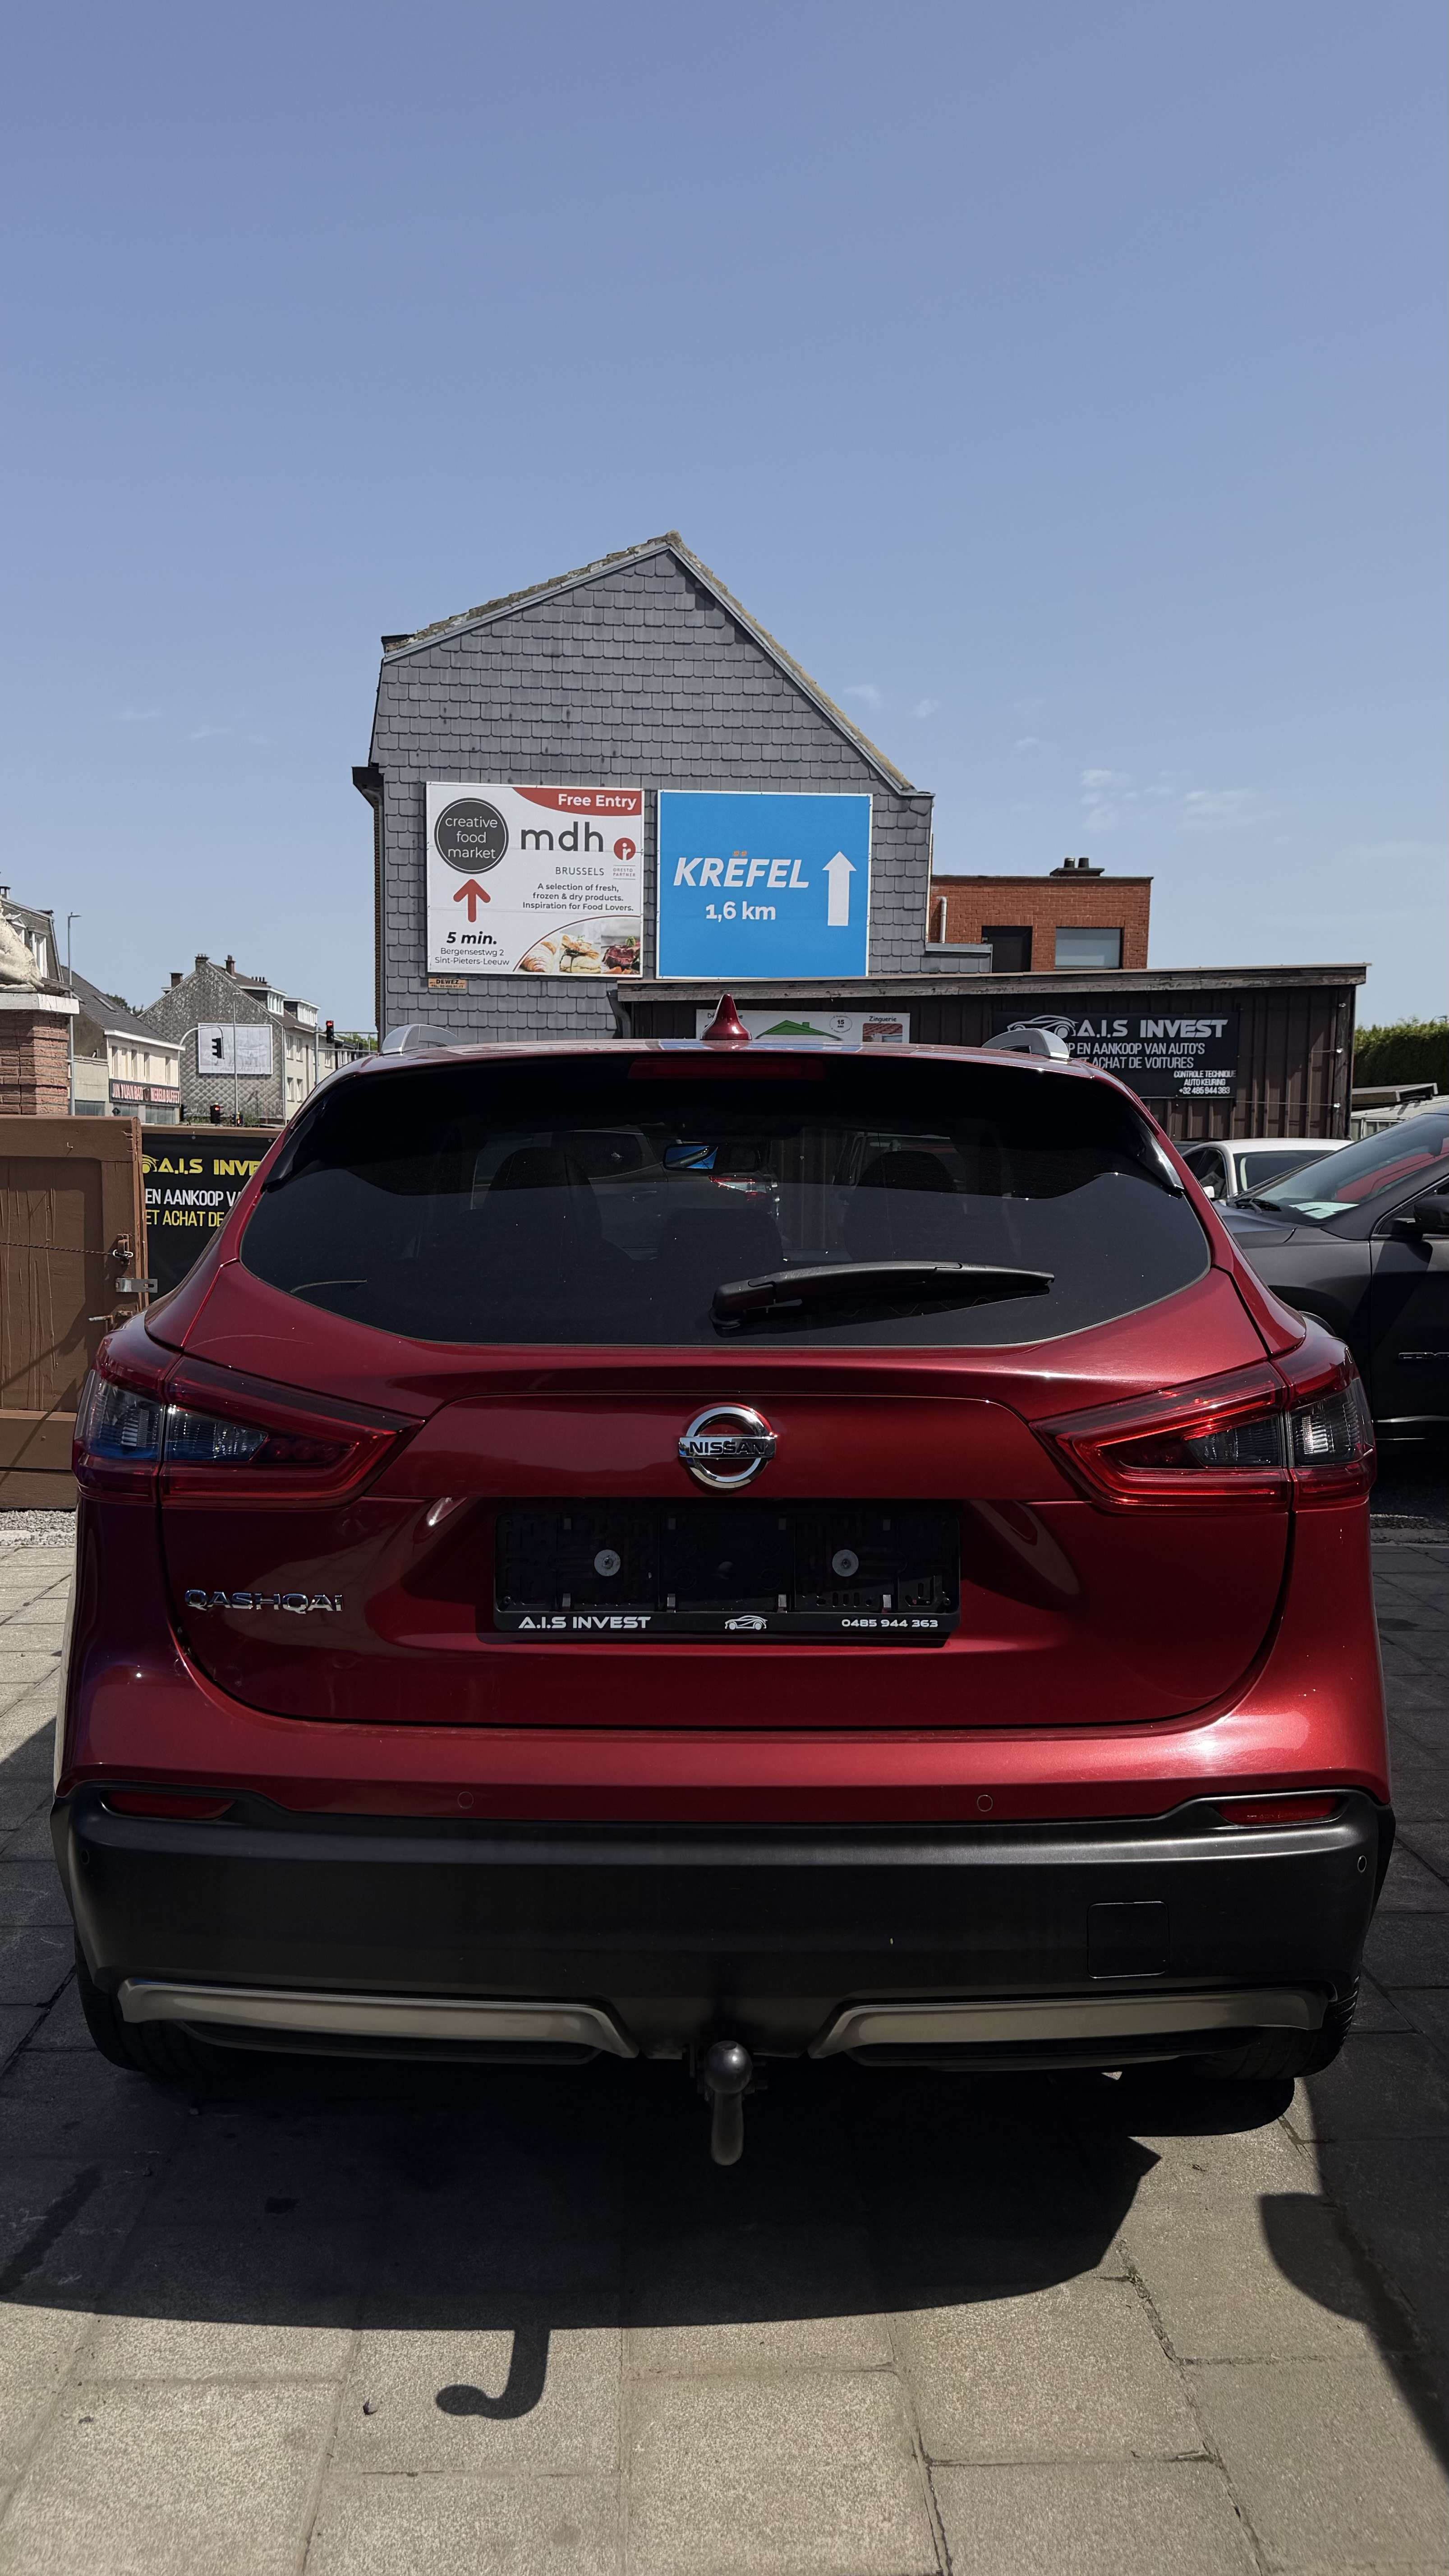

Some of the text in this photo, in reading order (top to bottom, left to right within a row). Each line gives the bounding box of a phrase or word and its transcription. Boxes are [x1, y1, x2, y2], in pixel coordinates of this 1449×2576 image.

[558, 793, 637, 810] Free Entry
[445, 816, 498, 828] creative
[456, 831, 486, 843] food
[521, 821, 603, 852] mdh
[447, 846, 496, 859] market
[555, 866, 605, 876] BRUSSELS
[595, 884, 619, 892] fresh,
[569, 893, 583, 902] dry
[585, 894, 624, 902] products.
[522, 902, 567, 910] Inspiration
[705, 901, 776, 922] 1,6 km
[446, 931, 497, 945] 5 min.
[440, 948, 497, 957] Bergensestwg
[435, 956, 510, 966] Sint-Pieters-Leeuw
[1076, 1019, 1228, 1038] A.I.S INVEST
[1077, 1043, 1091, 1055] EN
[1092, 1042, 1142, 1055] AANKOOP
[1144, 1043, 1167, 1055] VAN
[1168, 1043, 1205, 1055] AUTO'S
[1092, 1056, 1194, 1069] ACHAT DE VOITURES
[158, 1158, 262, 1176] A.I.S INVE
[145, 1188, 161, 1204] EN
[163, 1189, 224, 1206] AANKOOP
[146, 1210, 225, 1227] ET ACHAT DE
[689, 1440, 765, 1455] NISSAN
[185, 1589, 343, 1615] QASHQAI
[519, 1616, 651, 1629] A.I.S INVEST
[842, 1619, 938, 1628] 0485 944 363
